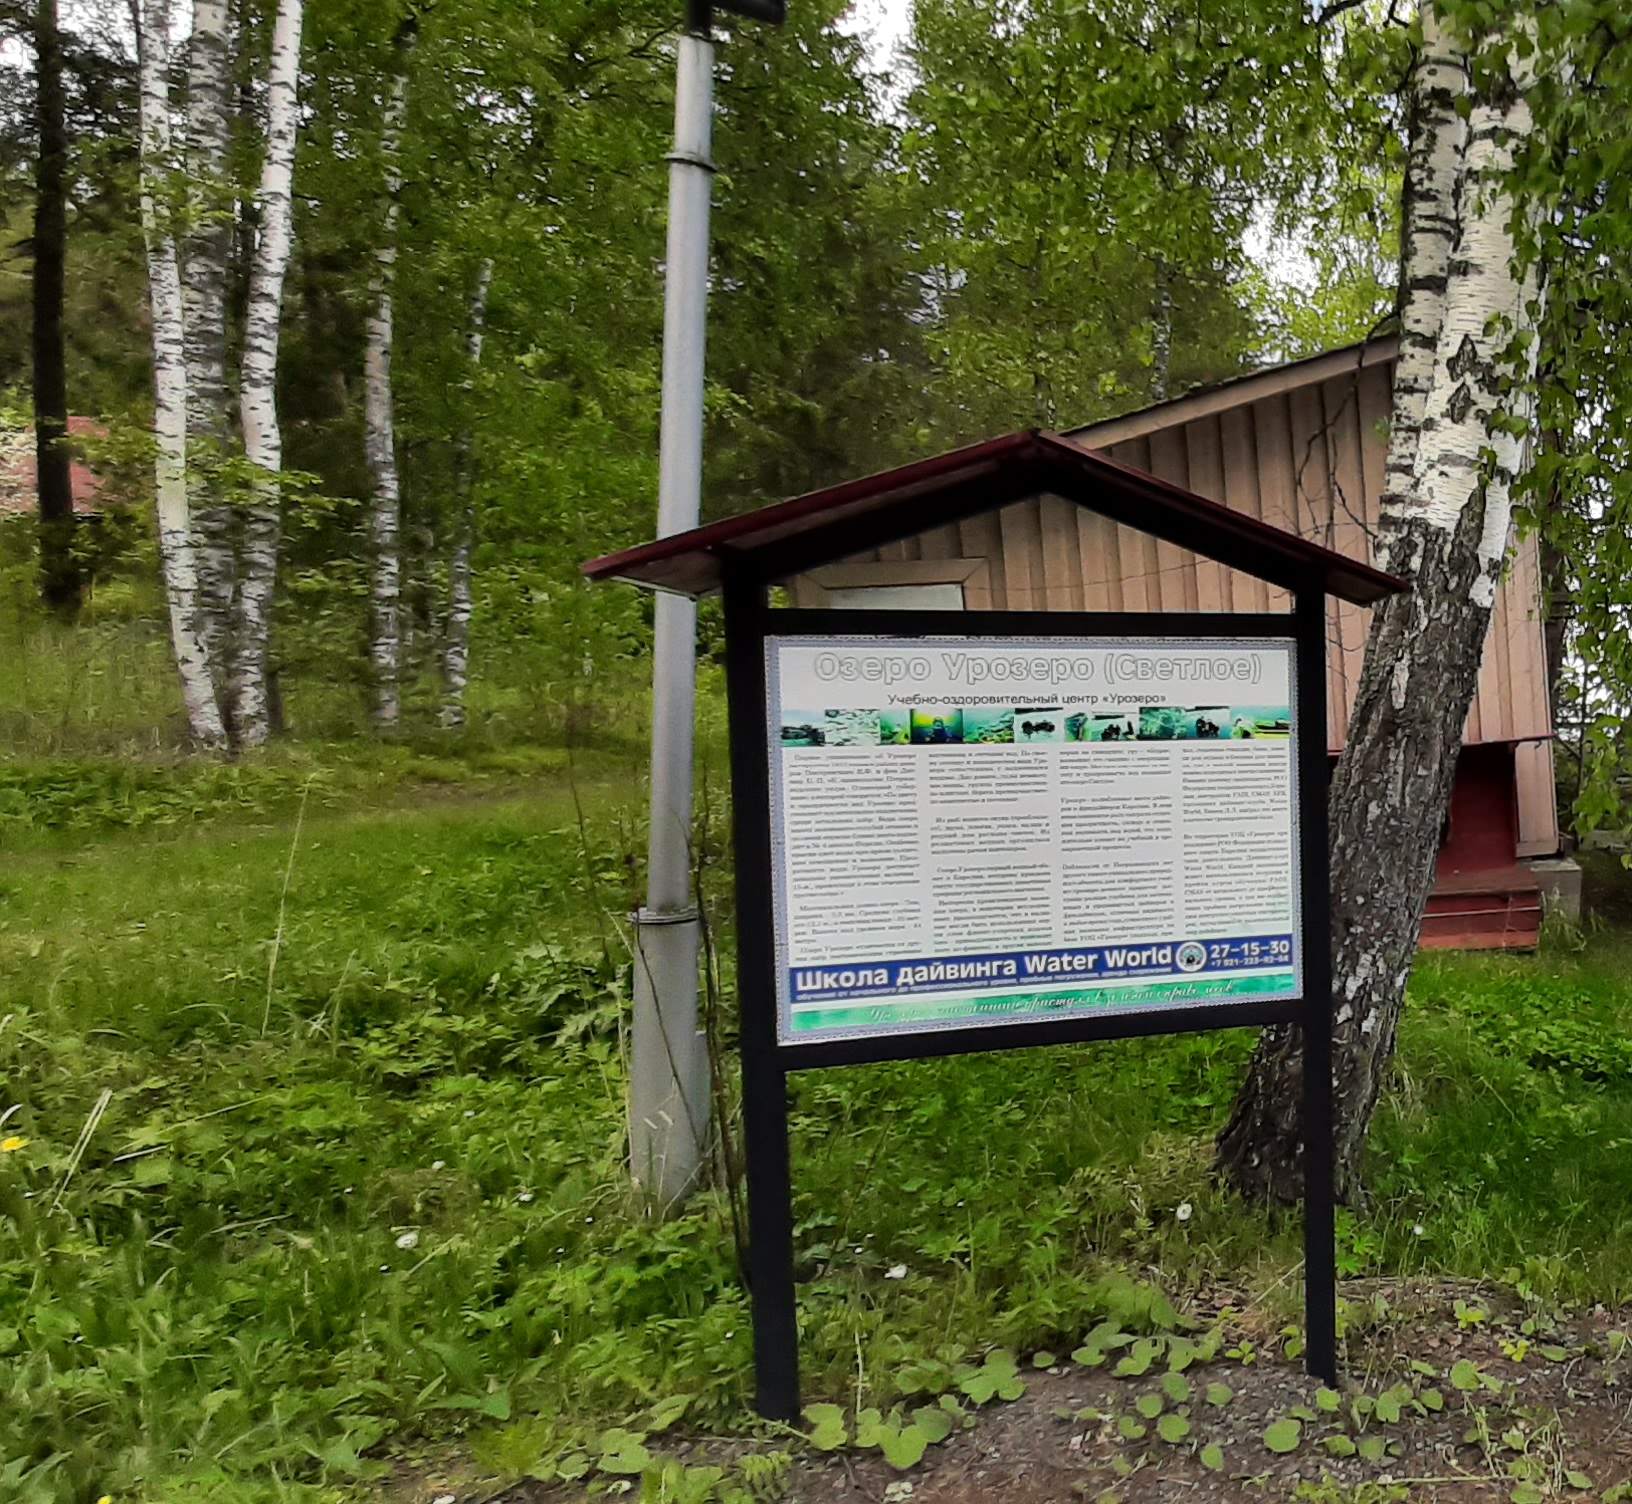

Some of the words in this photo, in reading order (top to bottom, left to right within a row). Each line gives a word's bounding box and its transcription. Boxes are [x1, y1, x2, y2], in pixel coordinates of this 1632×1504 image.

[814, 652, 931, 685] Озеро
[941, 653, 1094, 685] Урозеро
[1104, 653, 1261, 685] (Светлое)
[888, 693, 1058, 706] Учебно-оздоровительный
[1062, 695, 1098, 706] центр
[1102, 693, 1166, 705] «Урозеро»
[796, 968, 889, 991] Школа
[896, 959, 1017, 986] дайвинга
[1024, 953, 1099, 974] Water
[1104, 946, 1172, 968] World
